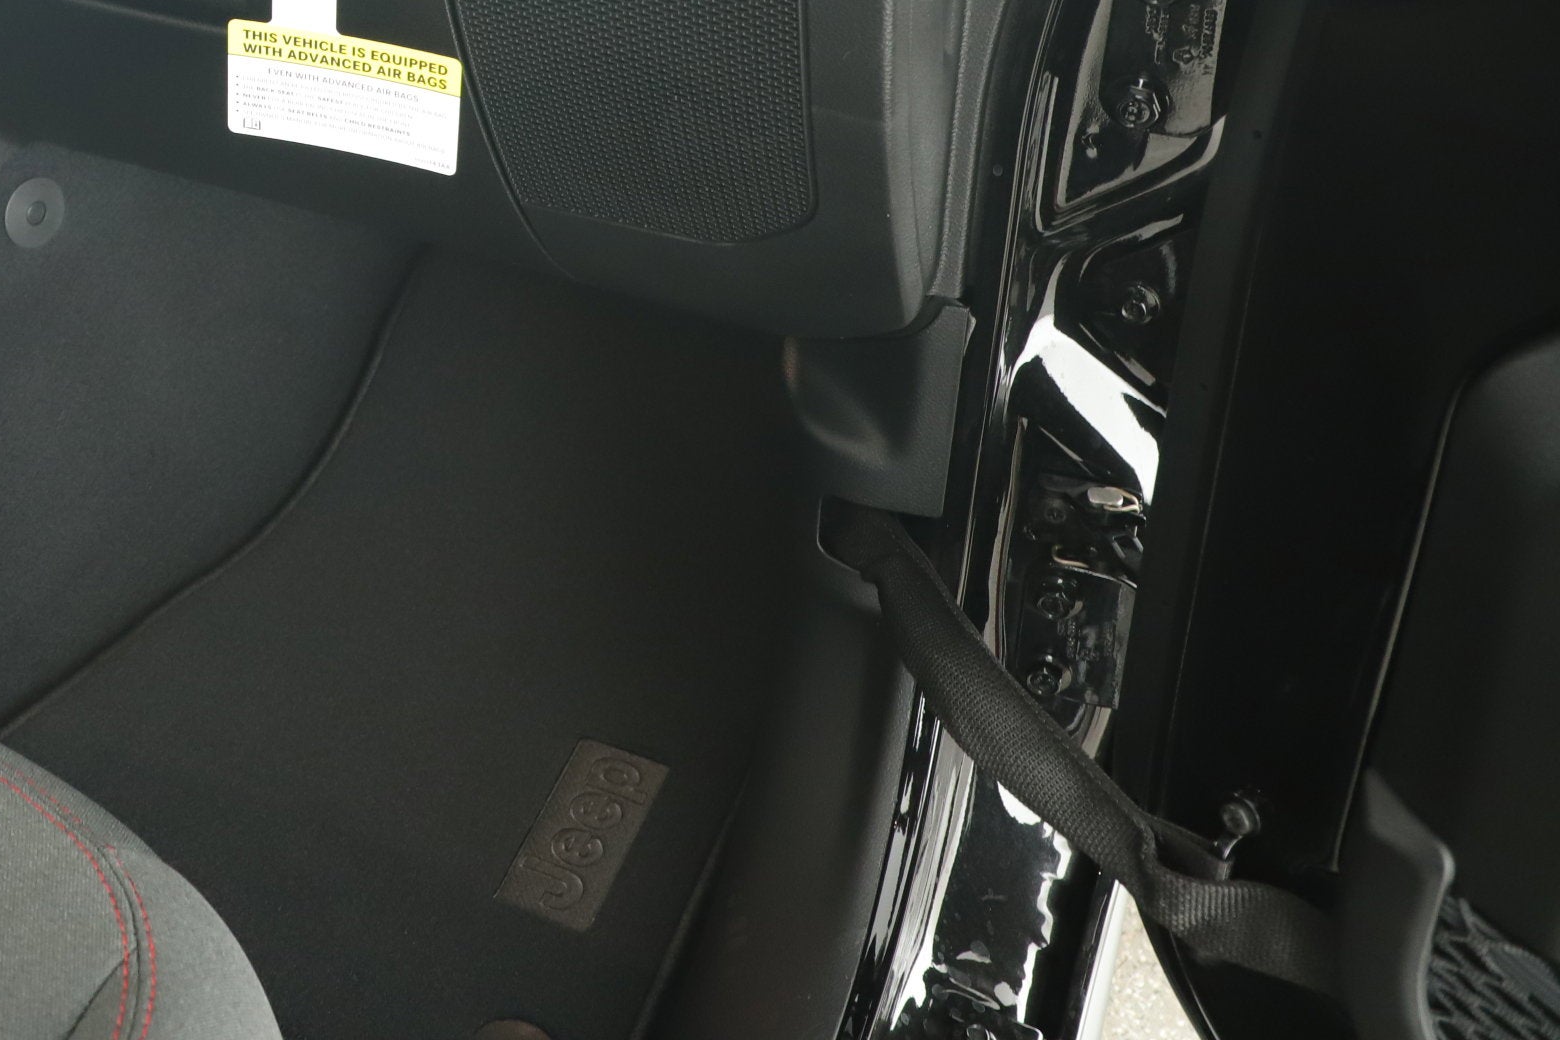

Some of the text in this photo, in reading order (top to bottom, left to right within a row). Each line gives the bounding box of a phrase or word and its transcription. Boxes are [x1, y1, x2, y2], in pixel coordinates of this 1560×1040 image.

[242, 29, 448, 76] THIS VEHICLE IS EQUIPPED
[242, 43, 448, 90] WITH ADVANCED AIR BAGS
[266, 67, 419, 103] EVEN WITH ADVANCED AIR BAGS
[518, 756, 648, 911] Jeep
